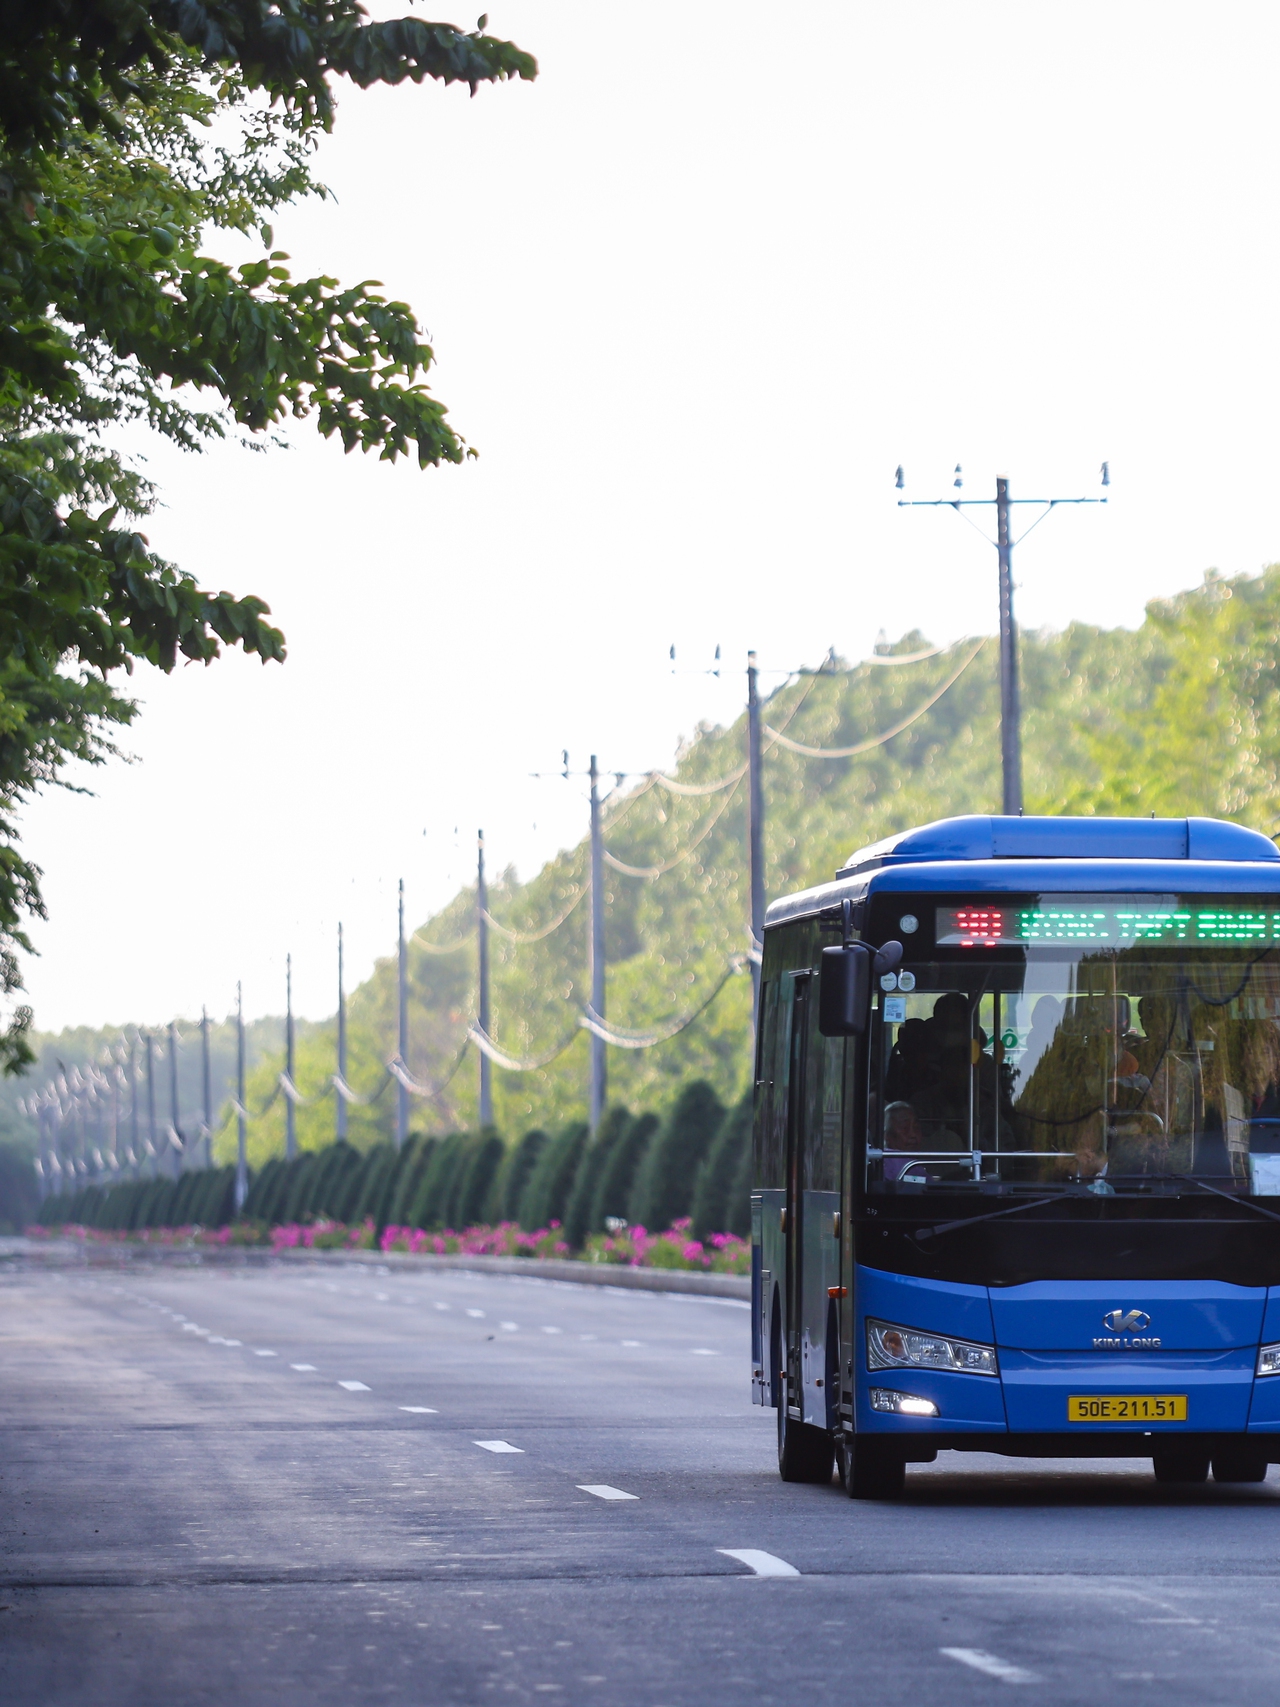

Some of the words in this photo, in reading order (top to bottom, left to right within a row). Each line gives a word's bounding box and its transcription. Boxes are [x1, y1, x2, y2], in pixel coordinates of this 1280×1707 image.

[1092, 1337, 1122, 1349] KIM
[1124, 1337, 1162, 1349] LONG
[1078, 1400, 1176, 1417] 50E-211.51
